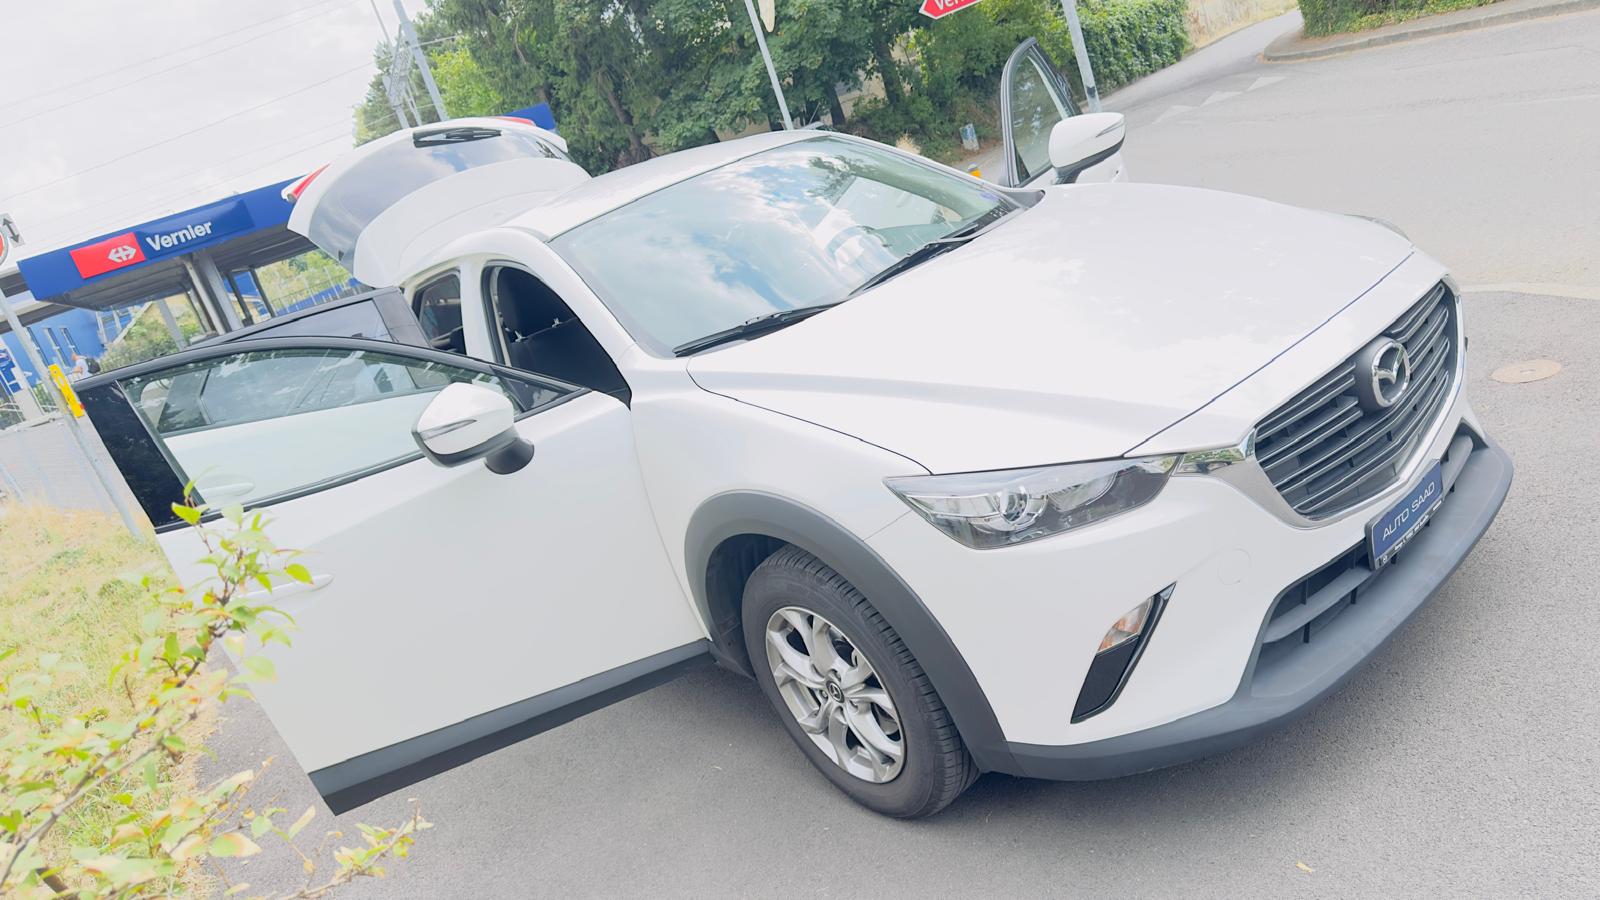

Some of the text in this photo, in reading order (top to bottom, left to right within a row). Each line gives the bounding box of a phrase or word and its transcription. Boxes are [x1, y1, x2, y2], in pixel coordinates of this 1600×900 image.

[145, 221, 212, 251] Vernier
[1383, 508, 1410, 541] AUTO
[1411, 481, 1435, 512] SAAD
